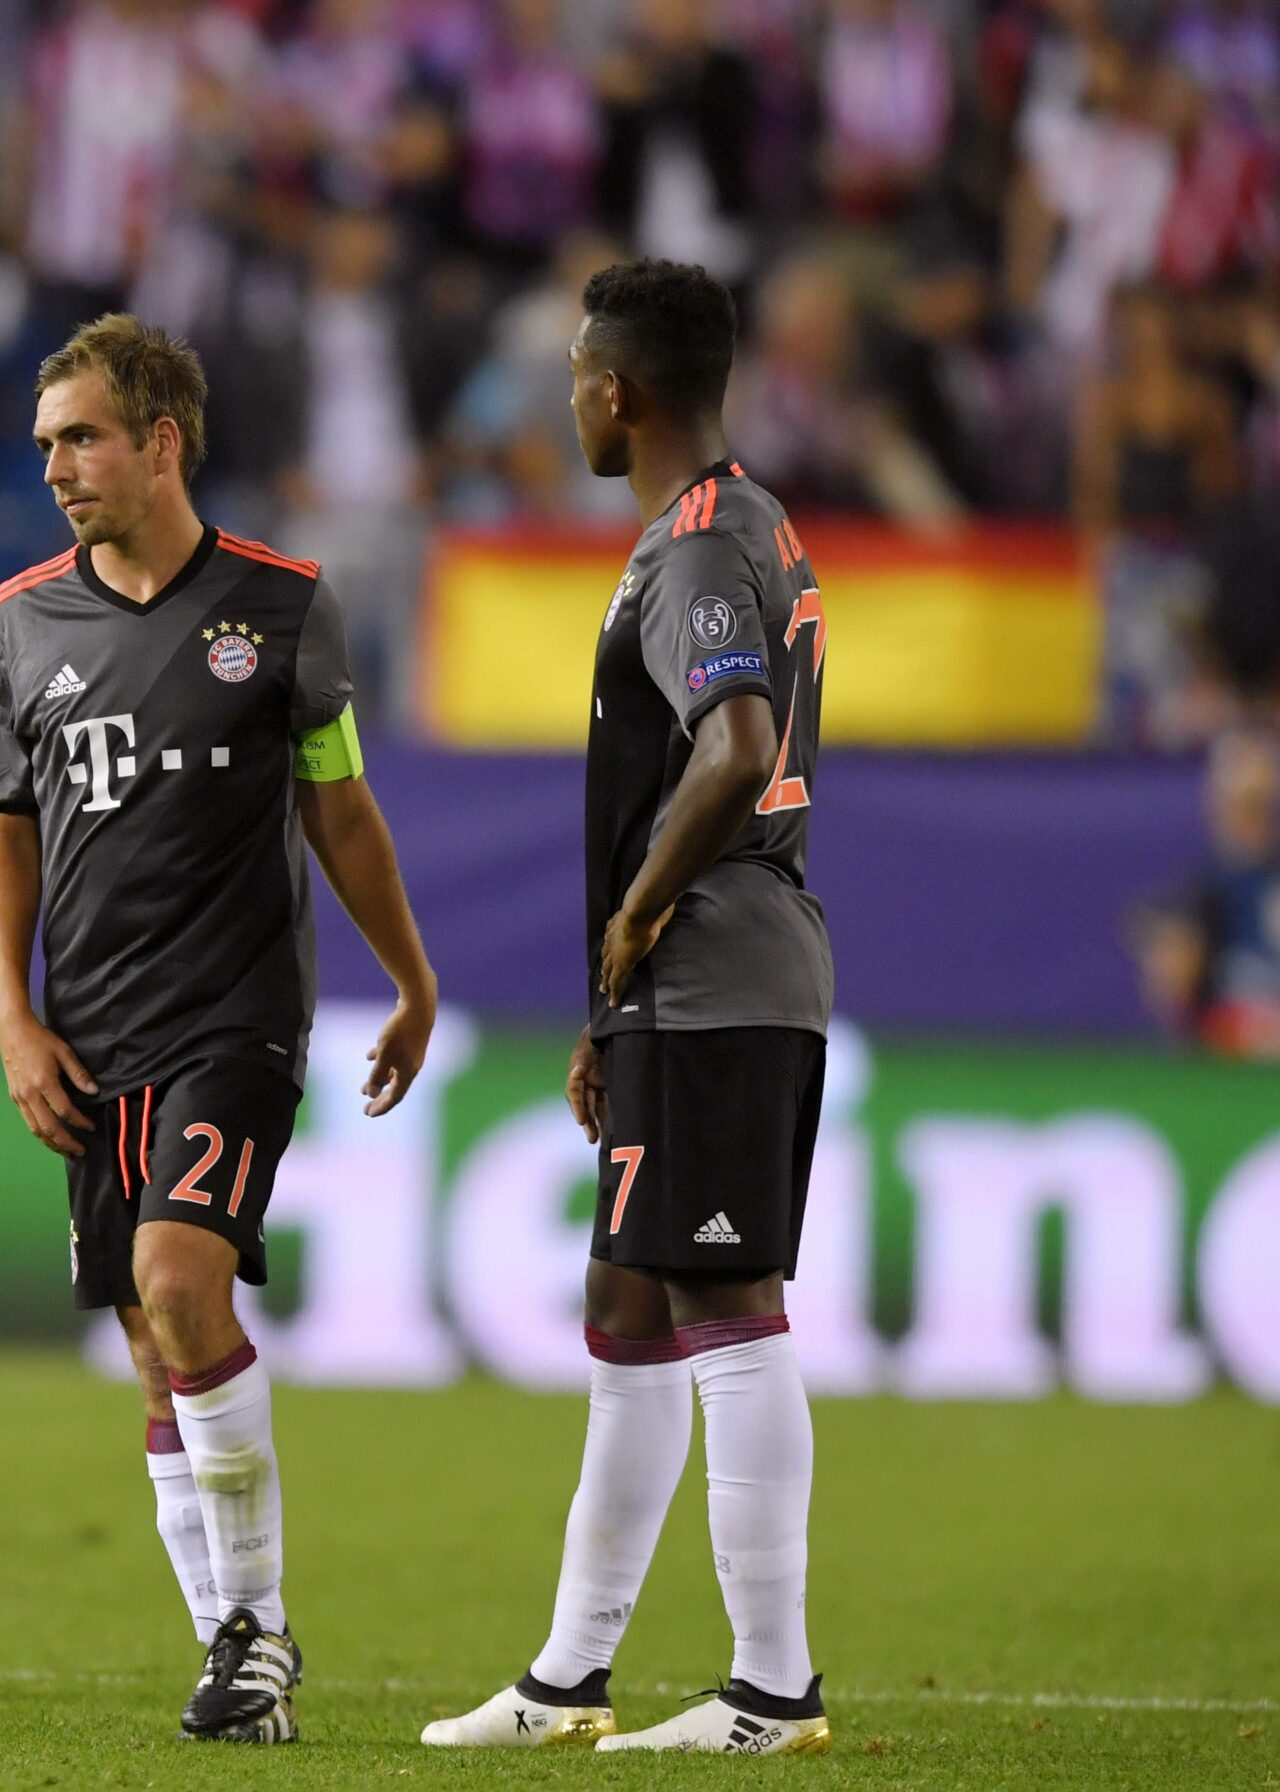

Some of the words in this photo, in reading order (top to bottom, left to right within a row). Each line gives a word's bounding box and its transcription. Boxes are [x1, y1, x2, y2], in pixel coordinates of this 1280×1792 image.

[708, 620, 720, 636] 5
[222, 638, 255, 658] BAYERN
[705, 656, 762, 676] RESPECT
[45, 681, 87, 699] adidas
[168, 1121, 255, 1219] 21
[609, 1145, 645, 1235] 7
[693, 1230, 741, 1244] adidas
[232, 1533, 269, 1554] FCB
